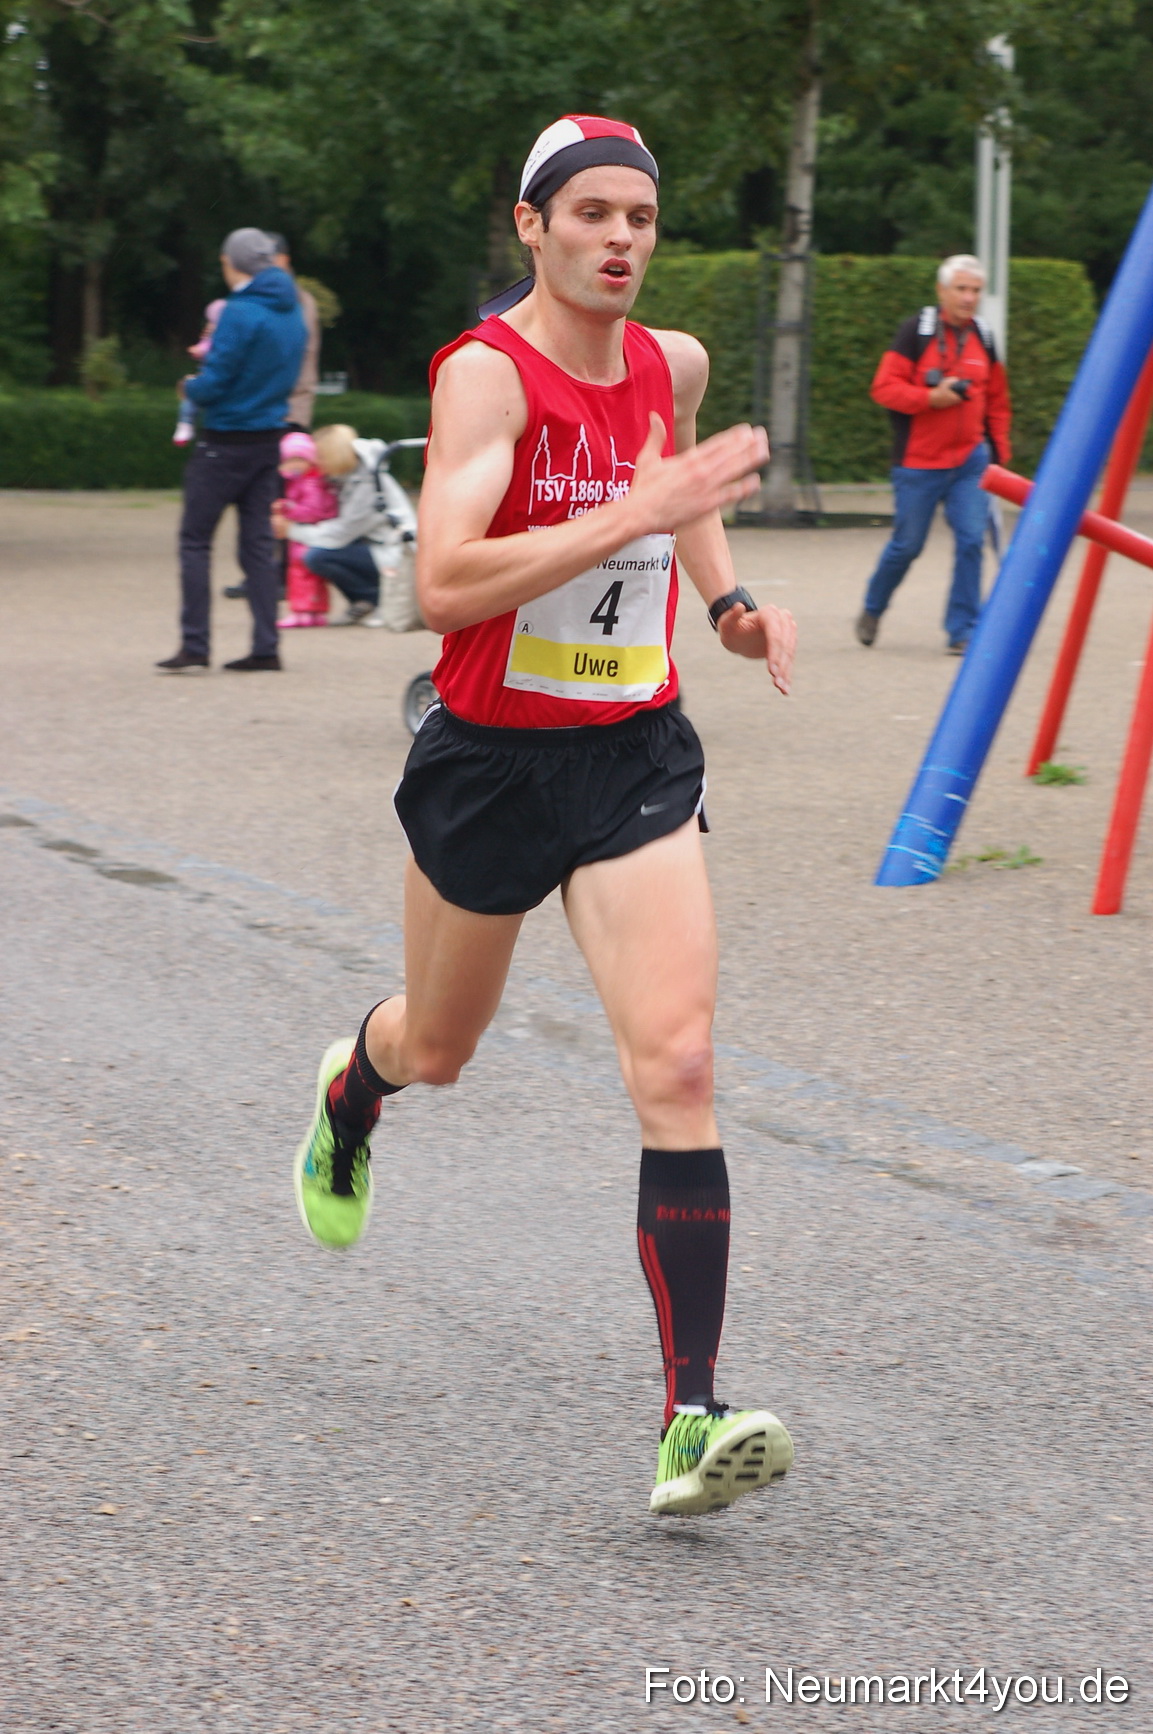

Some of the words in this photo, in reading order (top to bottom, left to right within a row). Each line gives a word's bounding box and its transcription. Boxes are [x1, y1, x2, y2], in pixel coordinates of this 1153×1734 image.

[535, 479, 566, 502] TSV
[569, 479, 604, 502] 1860
[567, 502, 599, 520] Lei
[596, 556, 659, 571] Neumarkt
[589, 580, 624, 636] 4
[521, 622, 530, 633] A
[573, 652, 619, 678] Uwe
